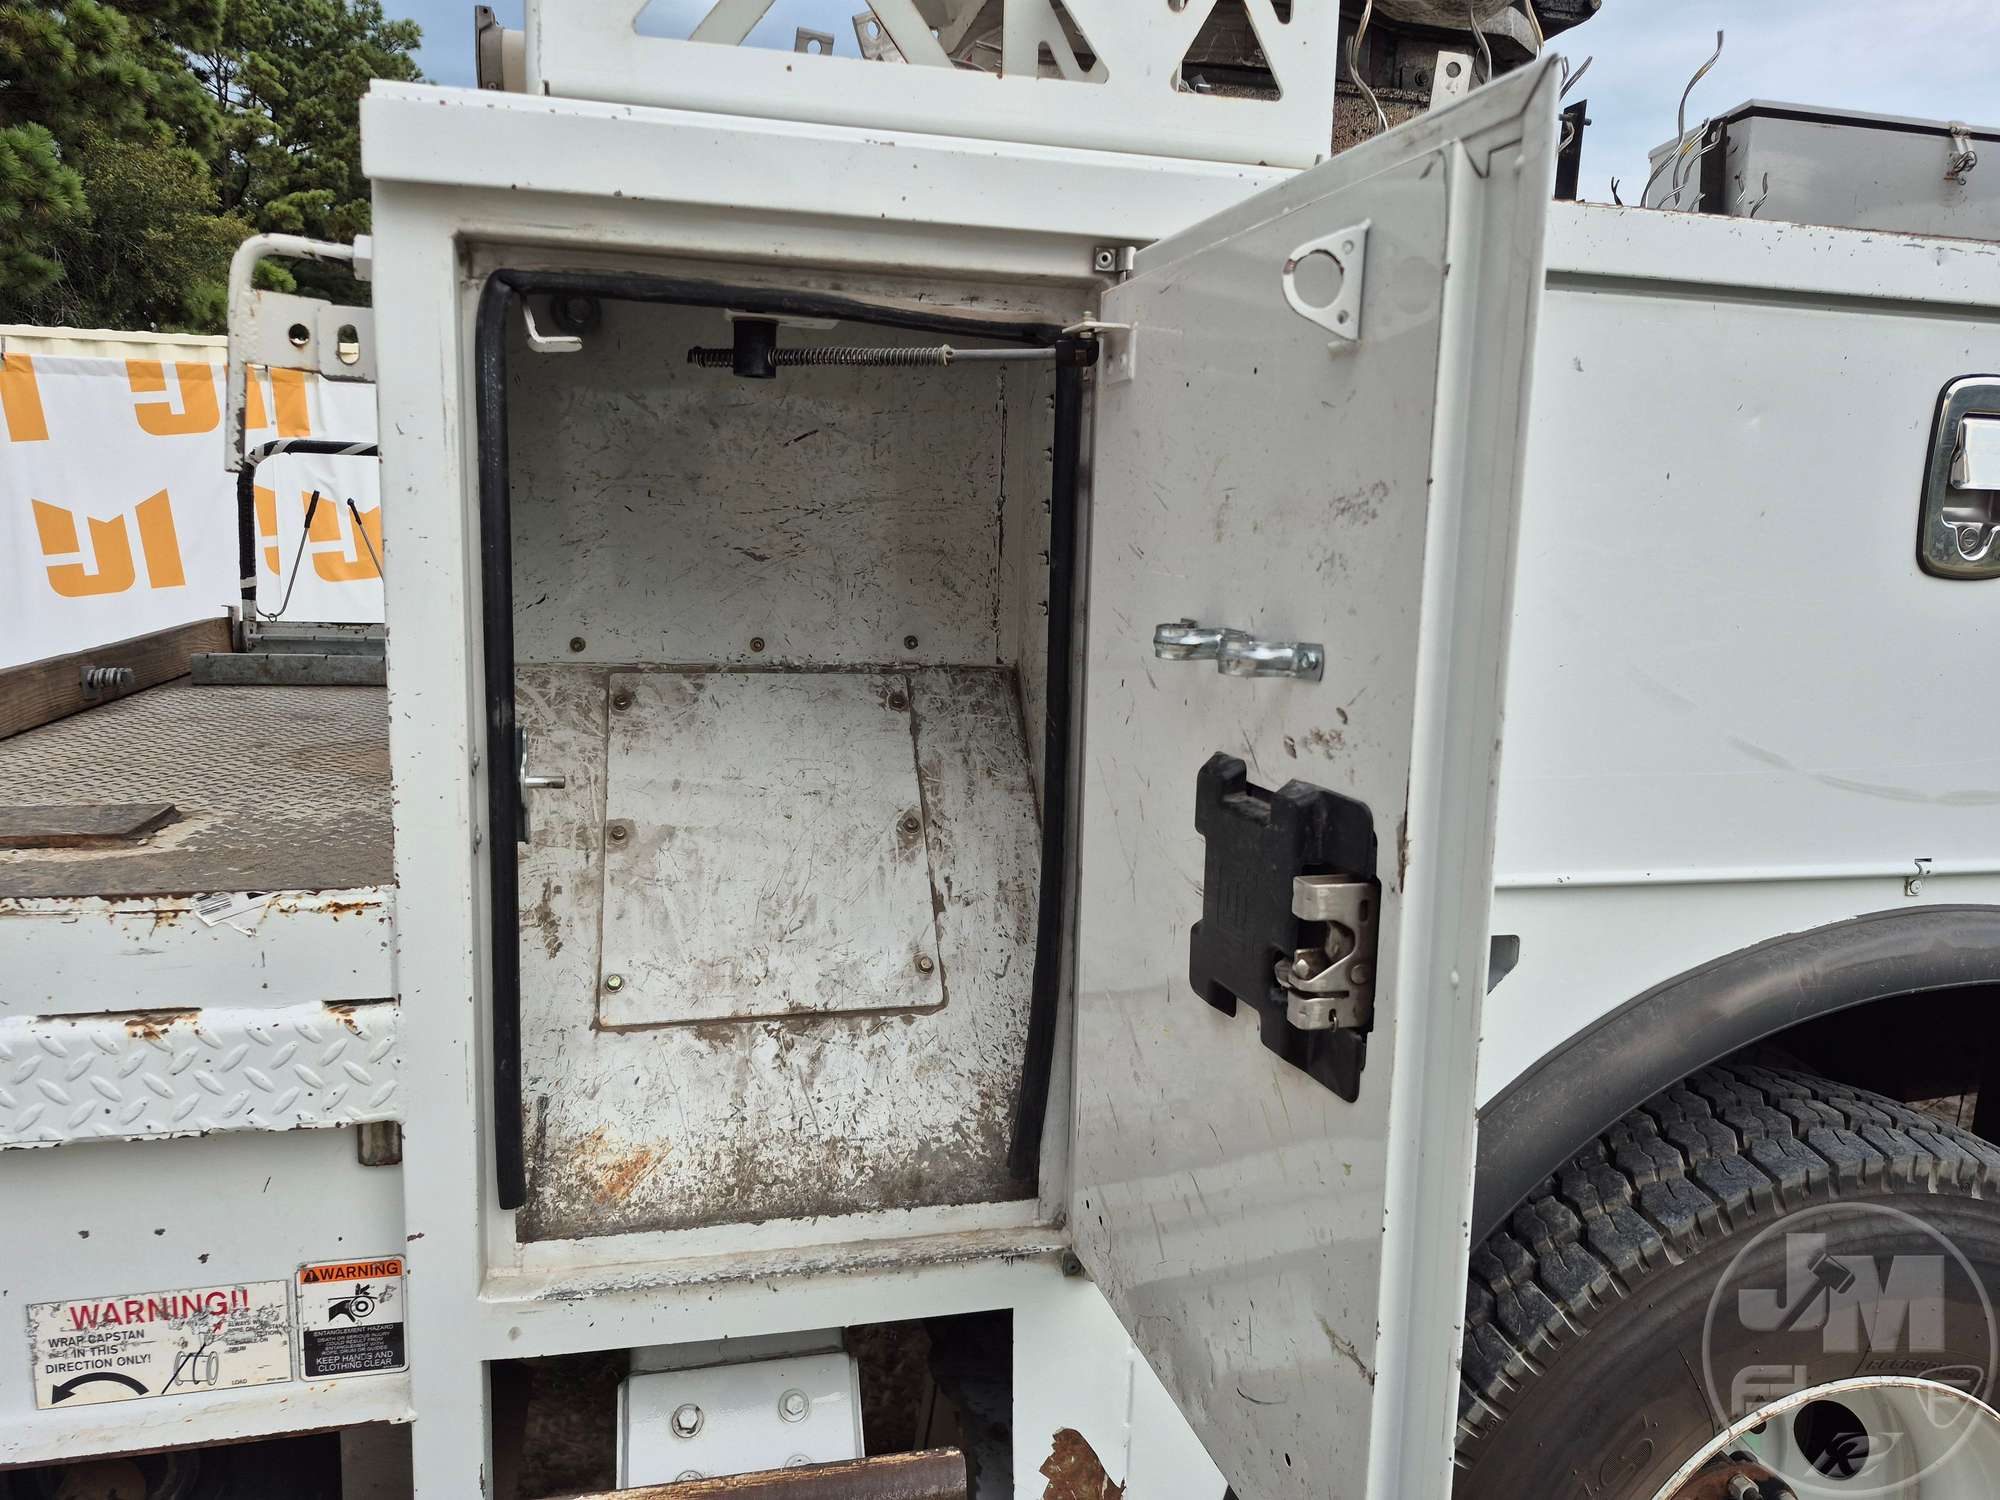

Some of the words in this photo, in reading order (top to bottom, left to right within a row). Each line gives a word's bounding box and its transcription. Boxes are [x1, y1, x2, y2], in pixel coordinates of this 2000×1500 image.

[319, 1262, 398, 1280] WARNING
[69, 1288, 250, 1331] WARNING!!
[48, 1336, 84, 1348] WRAP
[88, 1329, 145, 1343] CAPSTAN
[313, 1325, 366, 1337] ENTANGLEMENT
[367, 1324, 394, 1332] HAZARD
[73, 1347, 85, 1358] IN
[90, 1344, 118, 1356] THIS
[316, 1356, 340, 1365] KEEP
[342, 1353, 372, 1362] HANDS
[374, 1350, 394, 1359] AND
[46, 1359, 113, 1374] DIRECTION
[117, 1353, 151, 1367] ONLY!
[318, 1362, 362, 1372] CLOTHING
[363, 1358, 392, 1368] CLEAR
